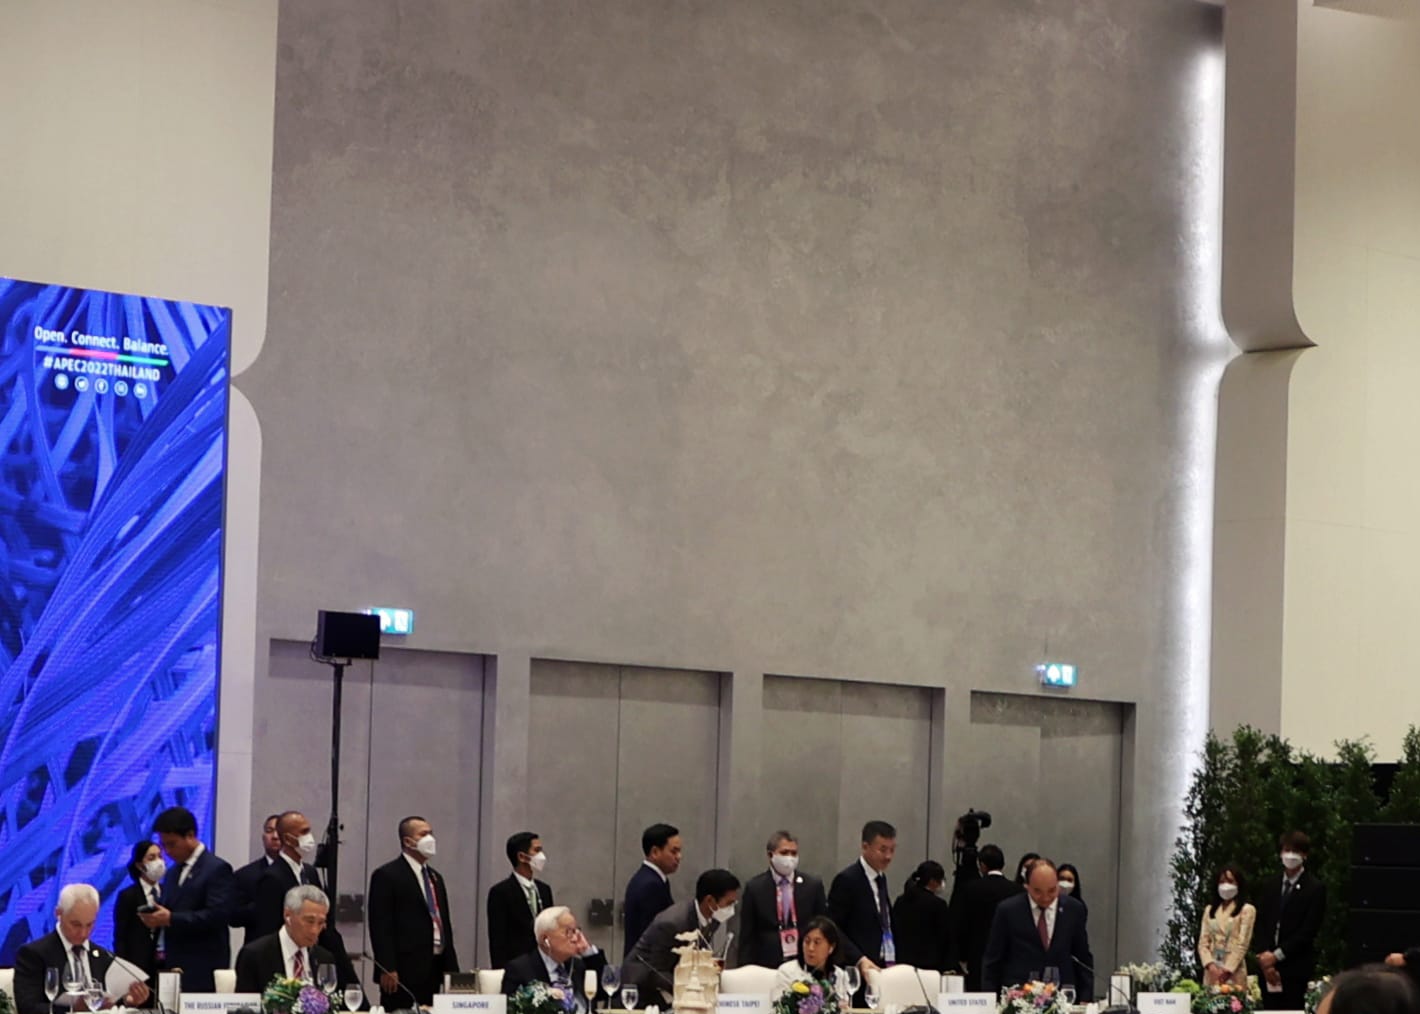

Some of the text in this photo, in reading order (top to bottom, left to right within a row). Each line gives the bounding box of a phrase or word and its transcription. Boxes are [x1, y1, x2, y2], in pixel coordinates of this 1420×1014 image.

[34, 325, 169, 355] Open. Connect. Balance.
[43, 355, 160, 381] #APEC2022THAILAND
[452, 1001, 489, 1009] SINGAPORE
